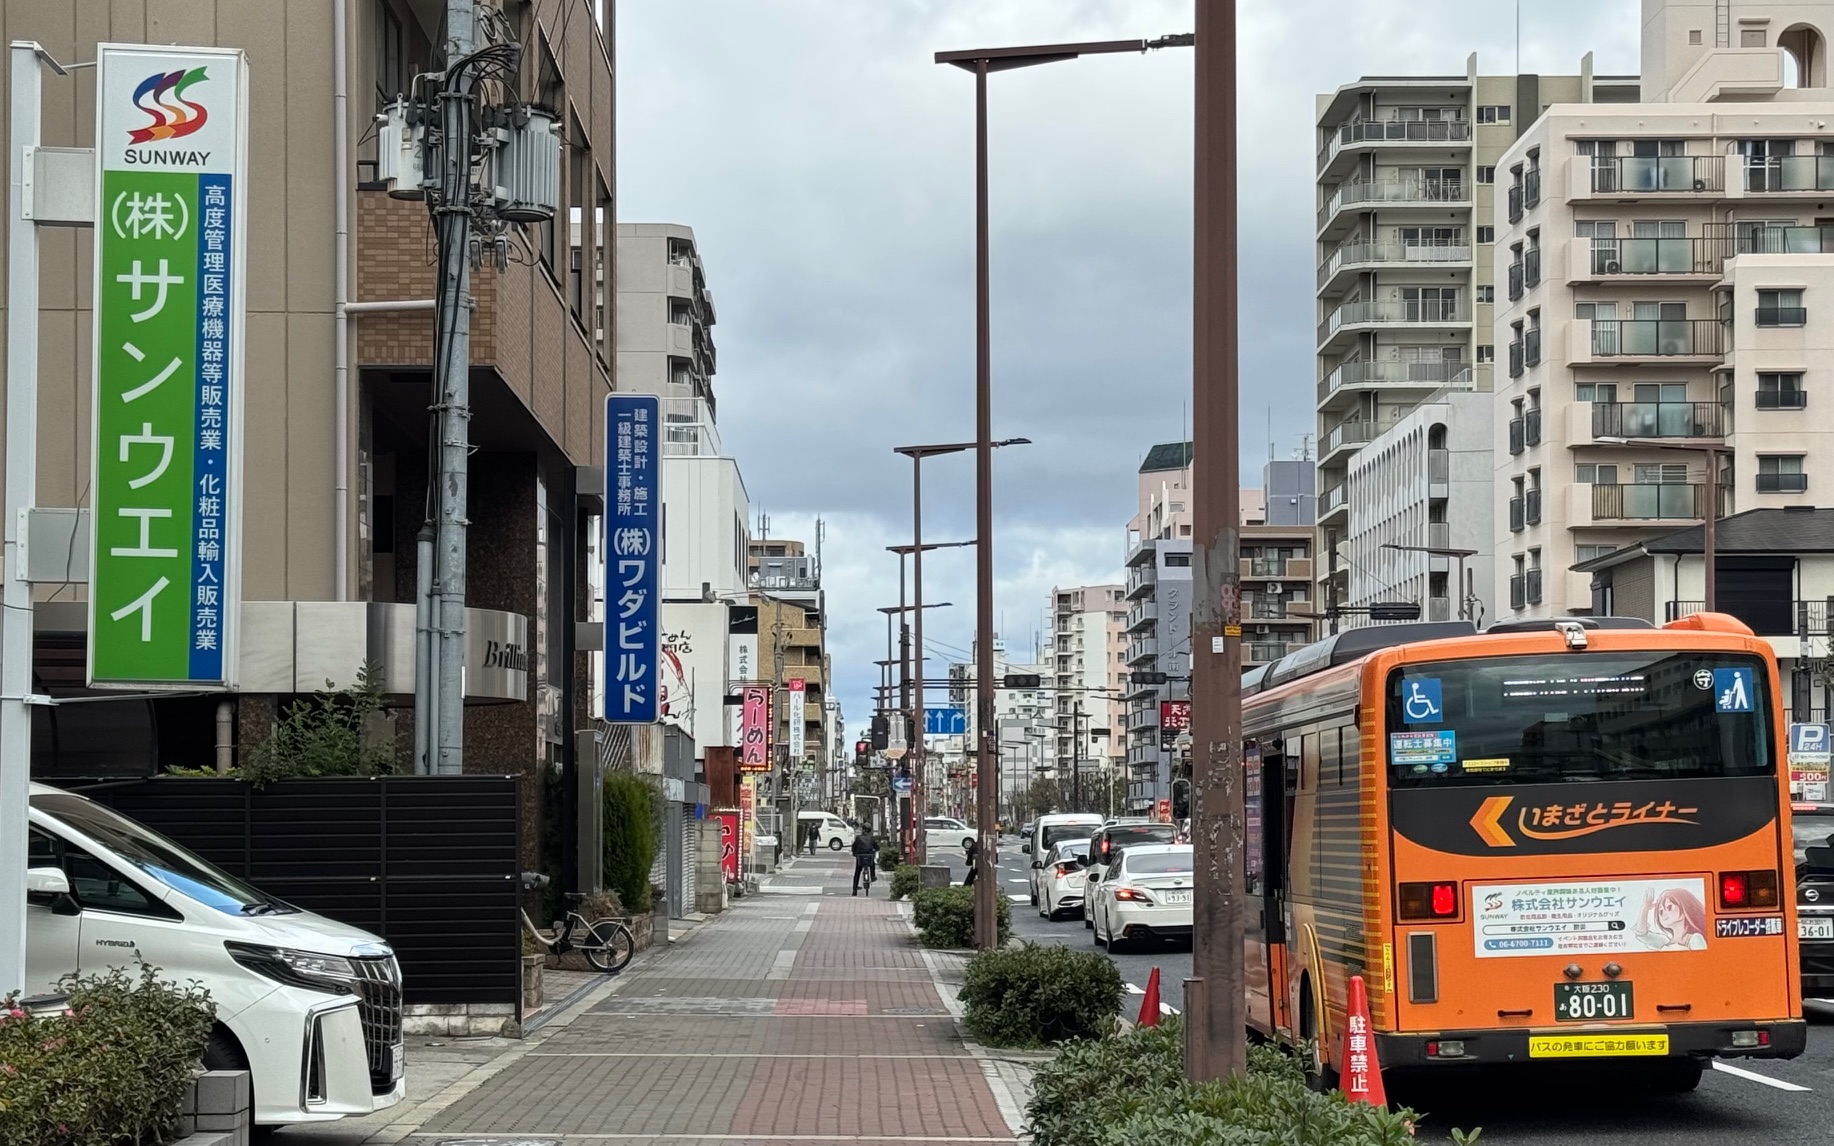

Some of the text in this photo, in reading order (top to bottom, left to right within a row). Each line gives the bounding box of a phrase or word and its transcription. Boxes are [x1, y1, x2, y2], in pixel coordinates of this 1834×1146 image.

[124, 149, 211, 166] SUNWAY
[111, 190, 189, 642] (株)サンウエイ
[196, 185, 226, 650] 高度管理医療機器等販売業・化粧品輸入販売業
[617, 412, 632, 516] 一級建築士事務所
[633, 408, 648, 516] 建築設計・施工
[614, 527, 651, 713] (株)ワダビルド
[746, 689, 764, 765] らーめん
[1797, 726, 1824, 751] P
[1393, 738, 1452, 749] 運転士募集中
[1804, 743, 1823, 751] 24H
[1518, 801, 1699, 829] いまざとライナー
[1511, 896, 1627, 911] 株式会社サンウエイ
[1510, 924, 1567, 932] 株式会社サンウエイ
[1800, 926, 1829, 937] 36-01
[1498, 938, 1549, 948] 06-6700-7111
[1573, 984, 1610, 993] 大阪230
[1569, 994, 1627, 1018] 80-01
[1349, 1015, 1369, 1093] 駐車禁止
[1530, 1040, 1666, 1053] バスの発車にご協力願います
